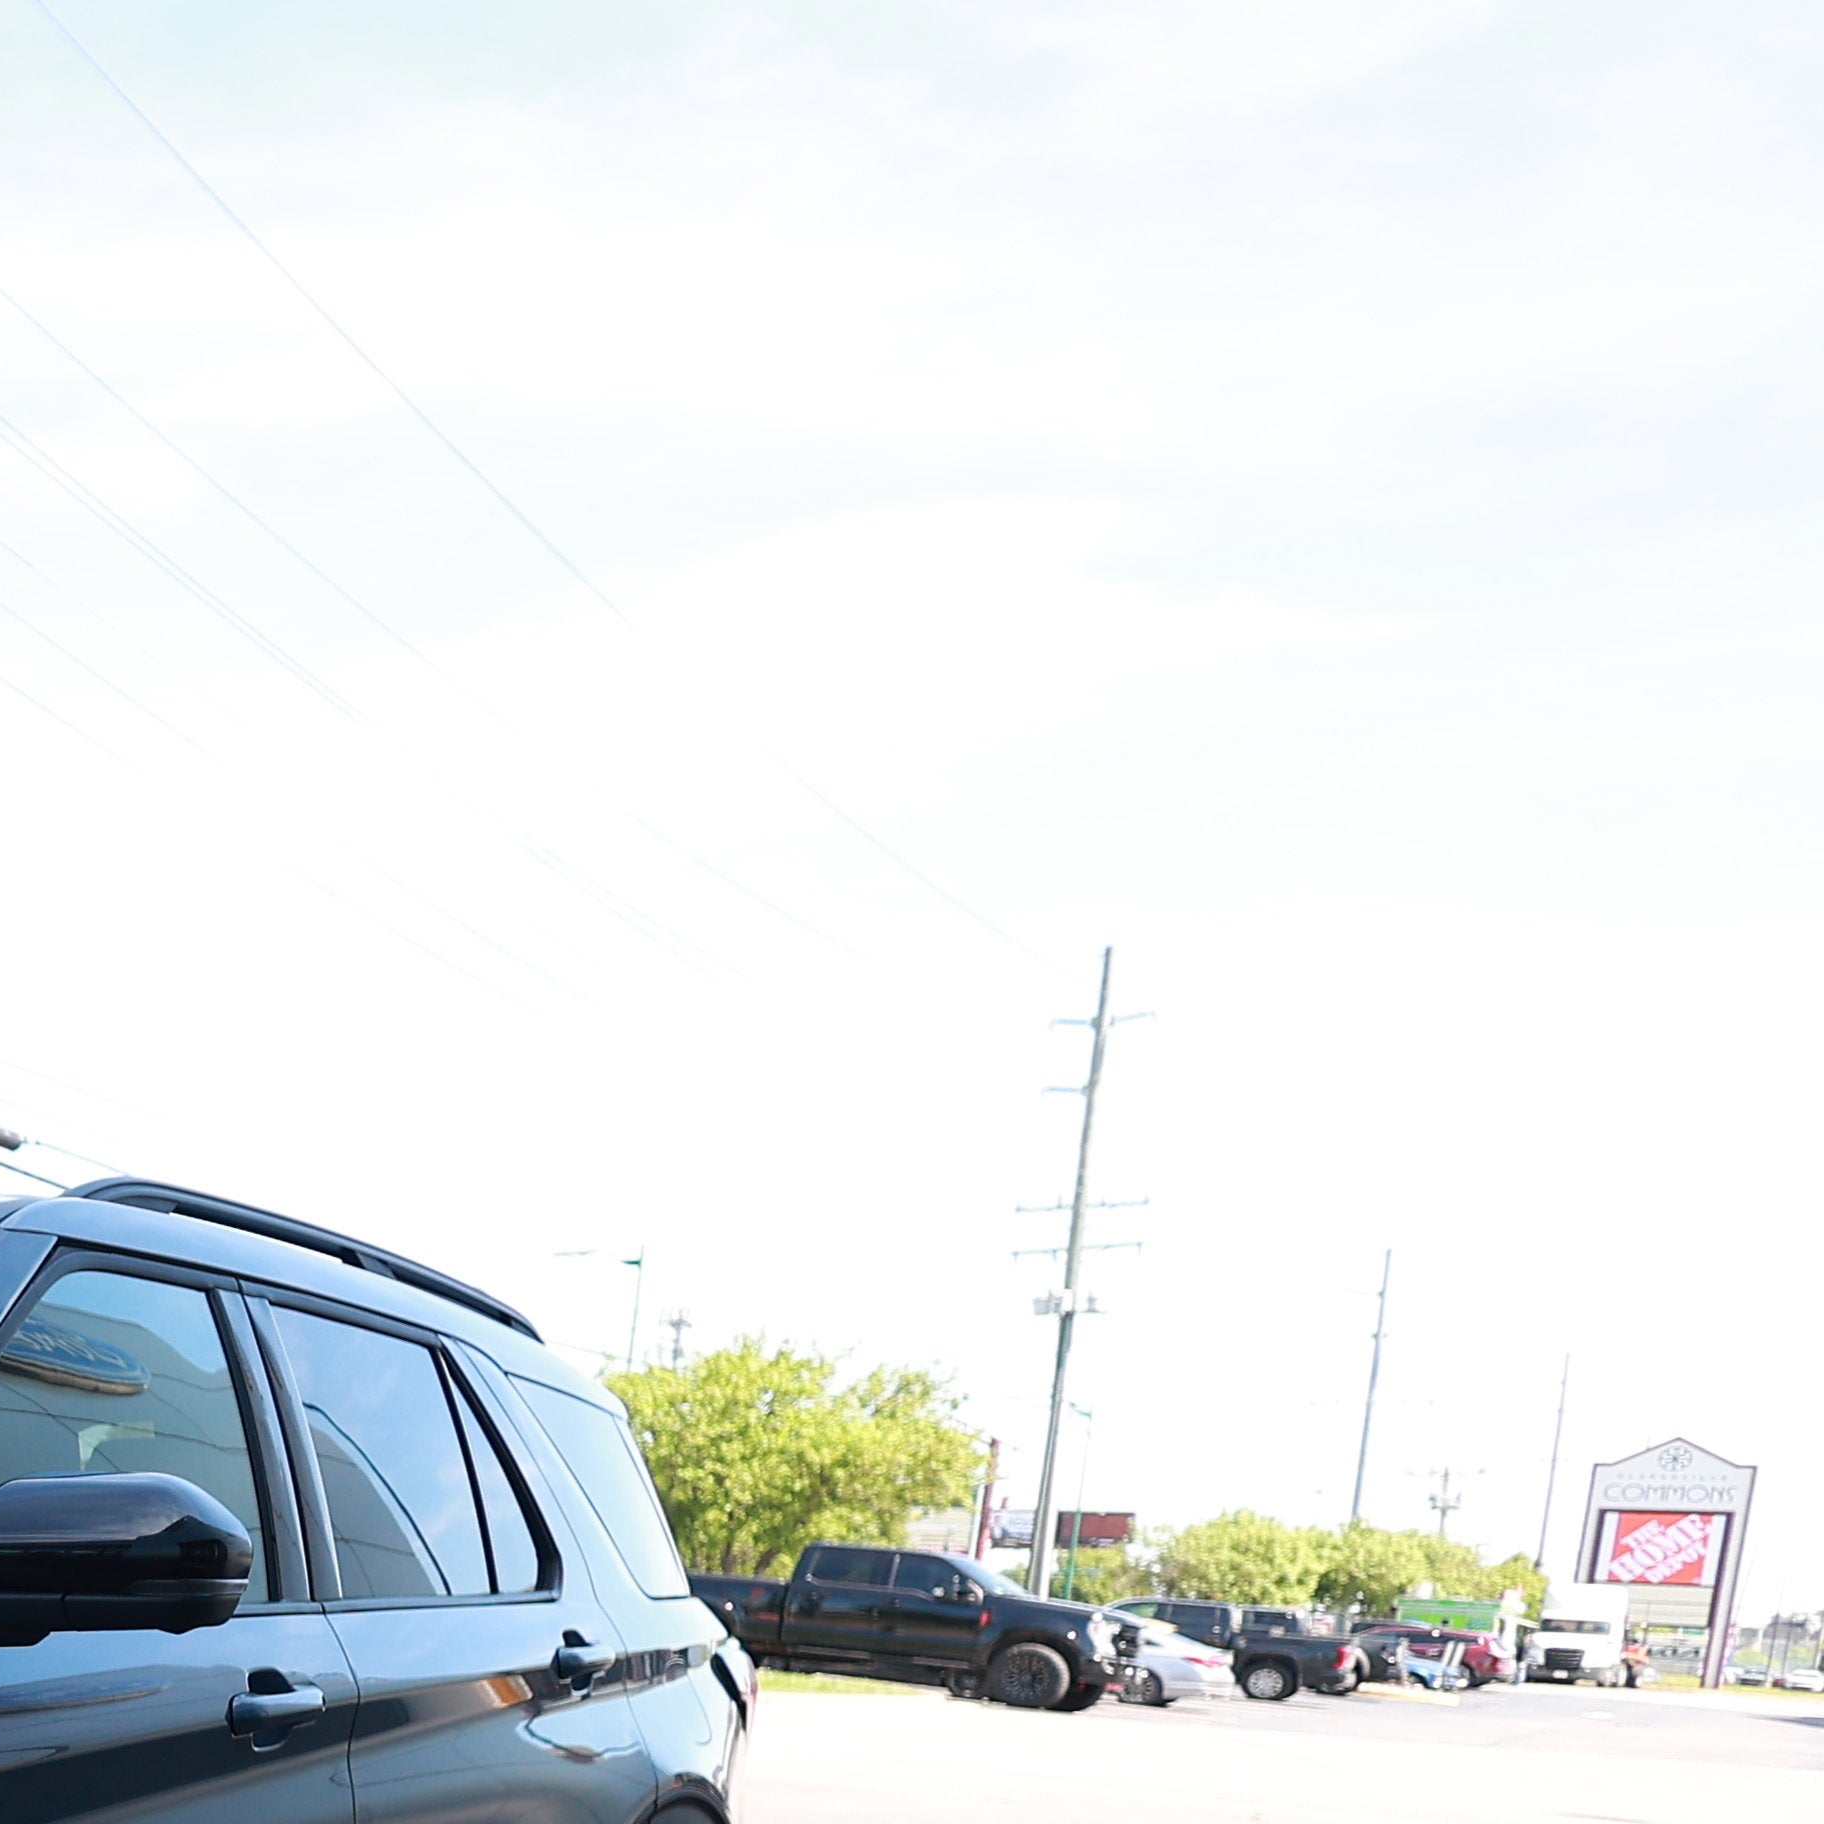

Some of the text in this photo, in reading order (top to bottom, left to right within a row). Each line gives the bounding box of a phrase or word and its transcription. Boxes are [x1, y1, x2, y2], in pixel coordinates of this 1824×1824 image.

[1604, 1481, 1739, 1504] COMMONS
[1609, 1512, 1709, 1582] HOME
[1619, 1518, 1667, 1549] THE
[1643, 1540, 1709, 1584] DEPOT
